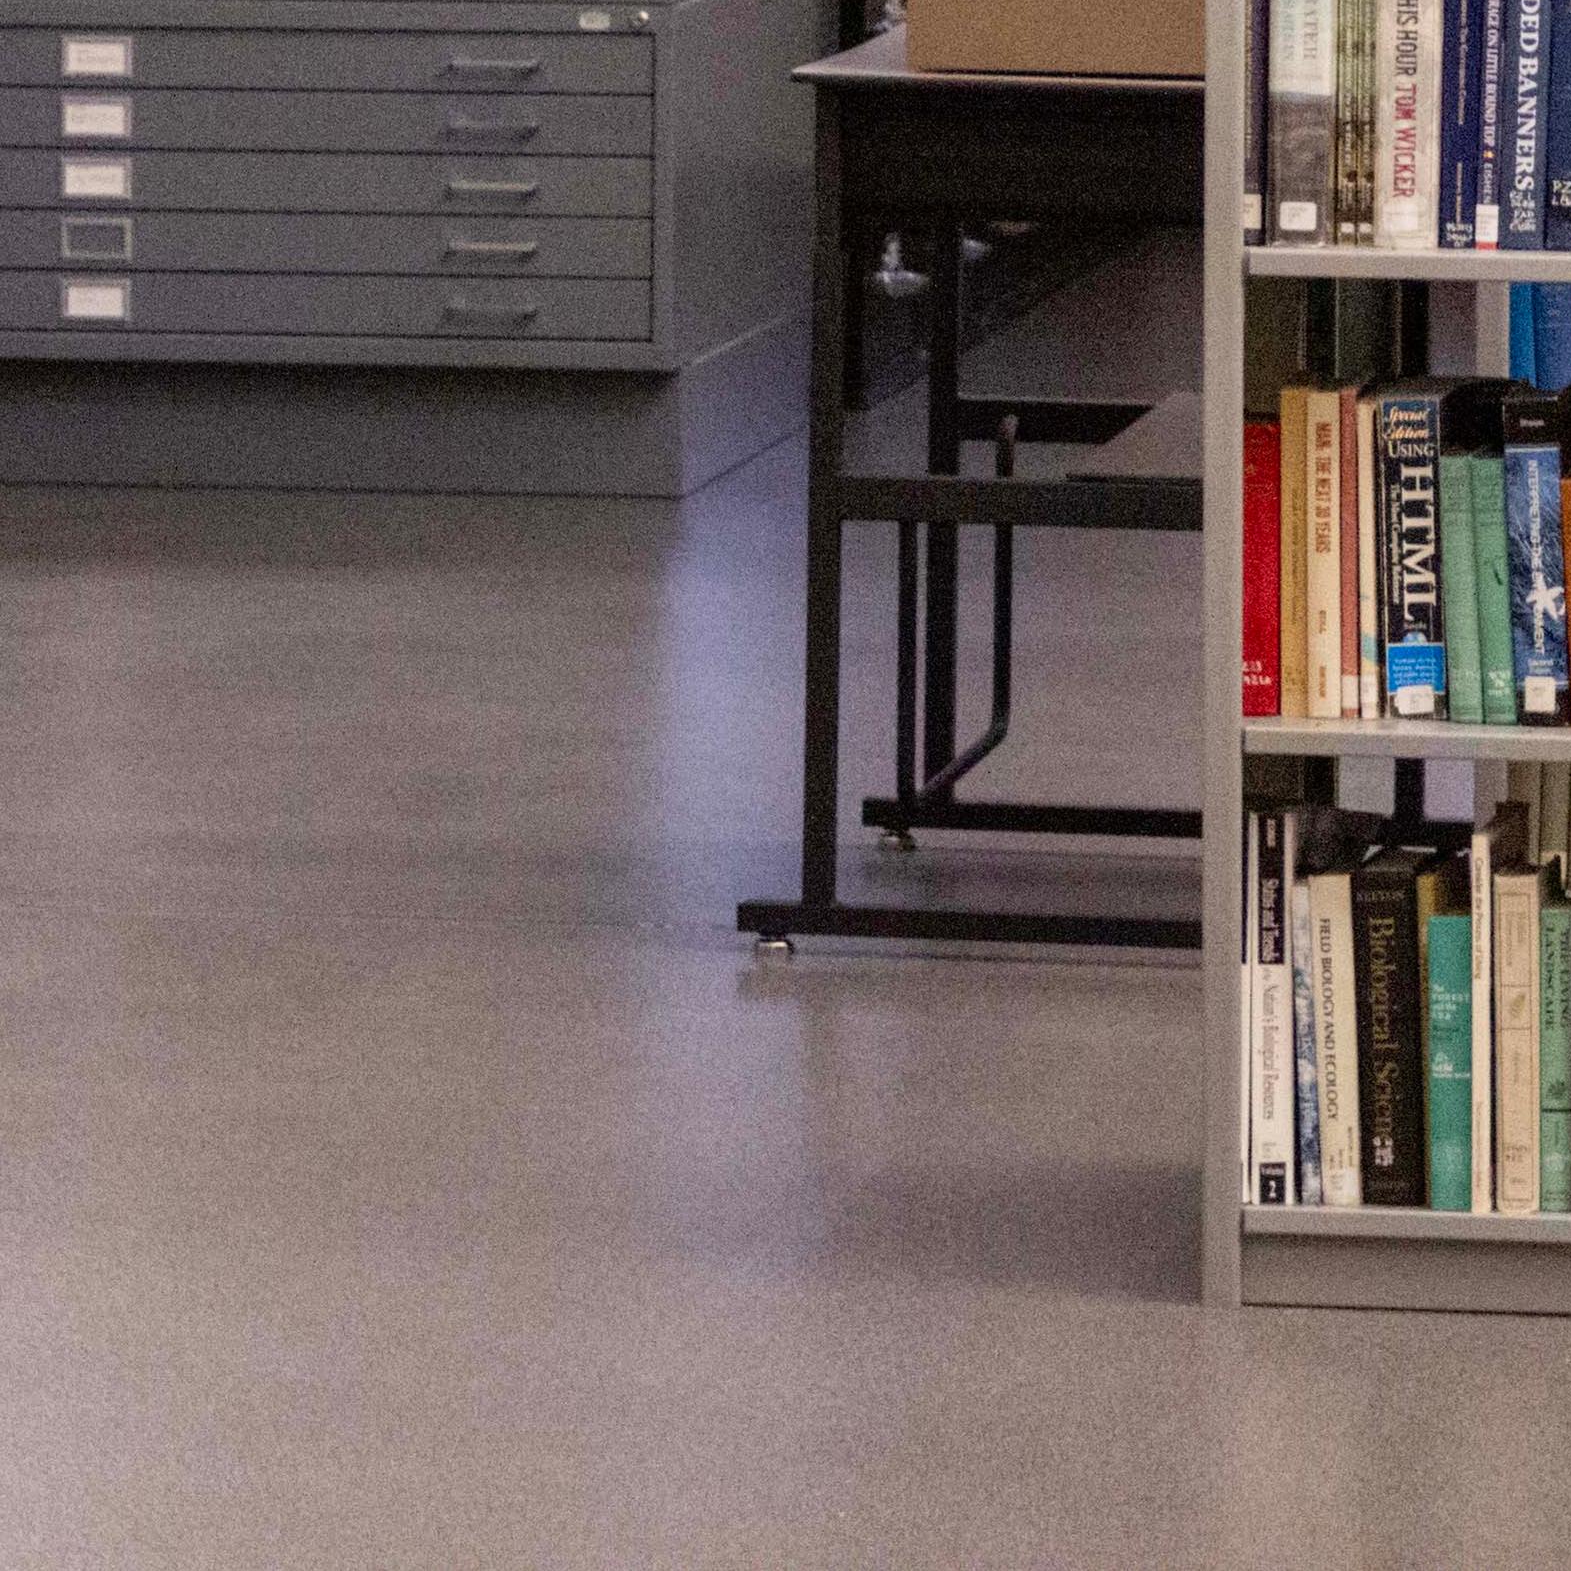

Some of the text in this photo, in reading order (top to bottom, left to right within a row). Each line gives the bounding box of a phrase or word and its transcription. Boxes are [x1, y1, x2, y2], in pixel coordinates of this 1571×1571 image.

[1396, 30, 1418, 76] HOUR
[1487, 29, 1499, 46] ON
[1486, 48, 1498, 81] LITTLE
[1395, 83, 1417, 121] TOM
[1484, 83, 1496, 123] ROUND
[1484, 125, 1495, 146] TOP
[1515, 57, 1538, 191] BANNERS
[1393, 126, 1417, 198] WICKER
[1315, 456, 1331, 476] THE
[1387, 443, 1435, 458] USING
[1315, 477, 1331, 503] NEXT
[1315, 522, 1331, 553] YEARS
[1400, 463, 1436, 622] HTML
[1474, 858, 1483, 894] Consider
[1262, 878, 1279, 963] Status and Trends
[1366, 917, 1401, 1050] Biological
[1544, 926, 1555, 1031] LANDSCAPE
[1559, 927, 1569, 1029] THE LIVING
[1319, 918, 1338, 1120] FIELD BIOLOGY AND ECOLOGY
